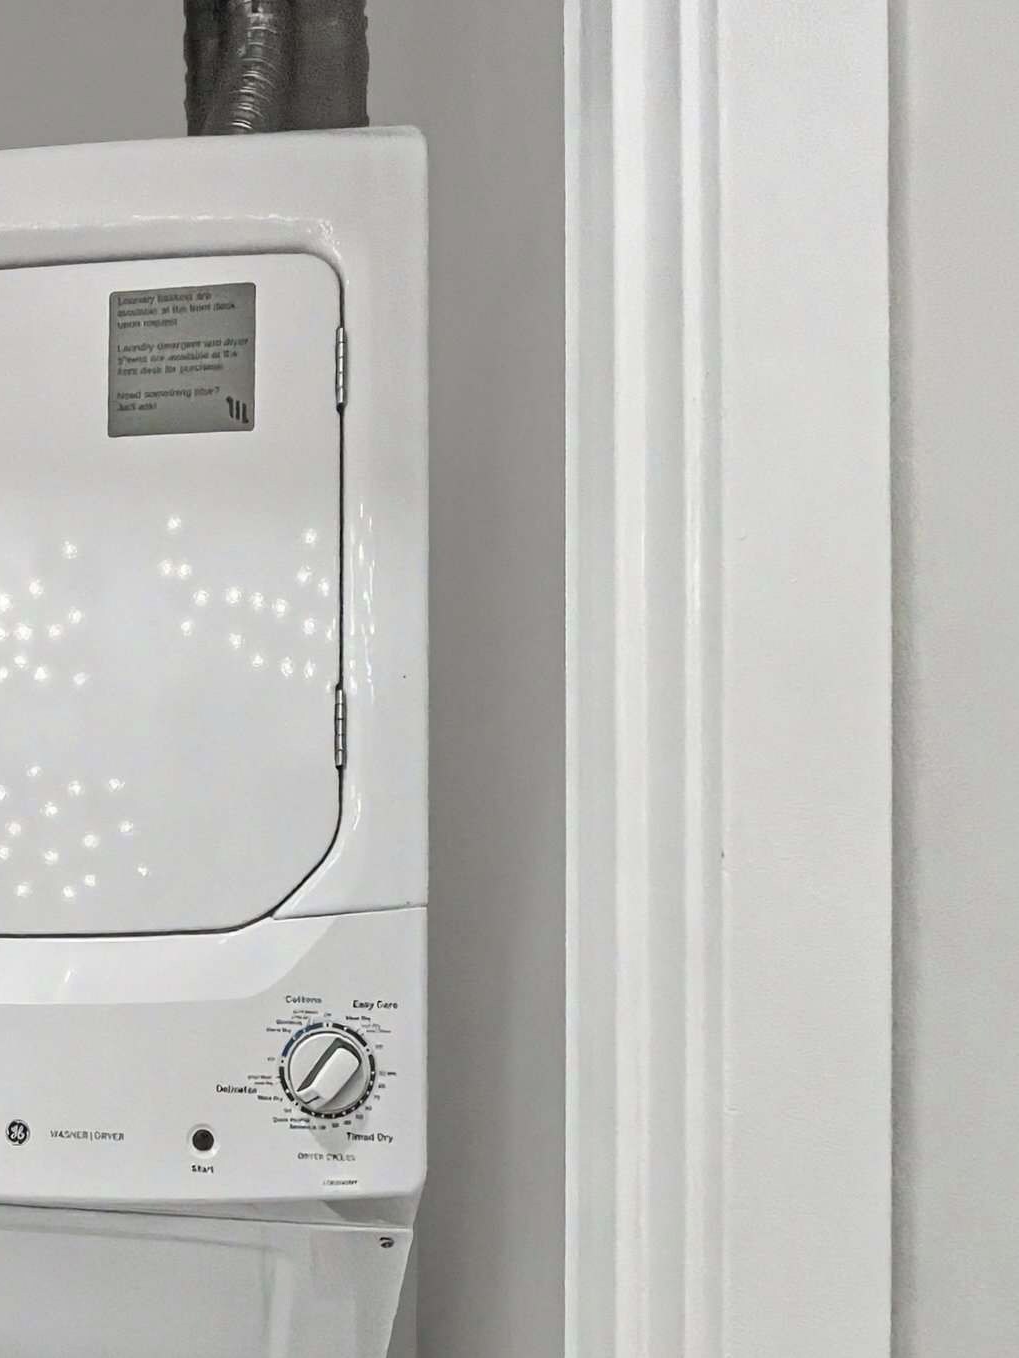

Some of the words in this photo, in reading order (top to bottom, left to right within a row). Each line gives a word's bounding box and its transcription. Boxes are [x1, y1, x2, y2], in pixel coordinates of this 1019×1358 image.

[285, 994, 323, 1004] Cottons
[352, 999, 375, 1011] Easy
[376, 1000, 399, 1009] Care
[346, 1131, 375, 1142] Timed
[377, 1132, 394, 1143] Dry
[191, 1164, 214, 1174] Start
